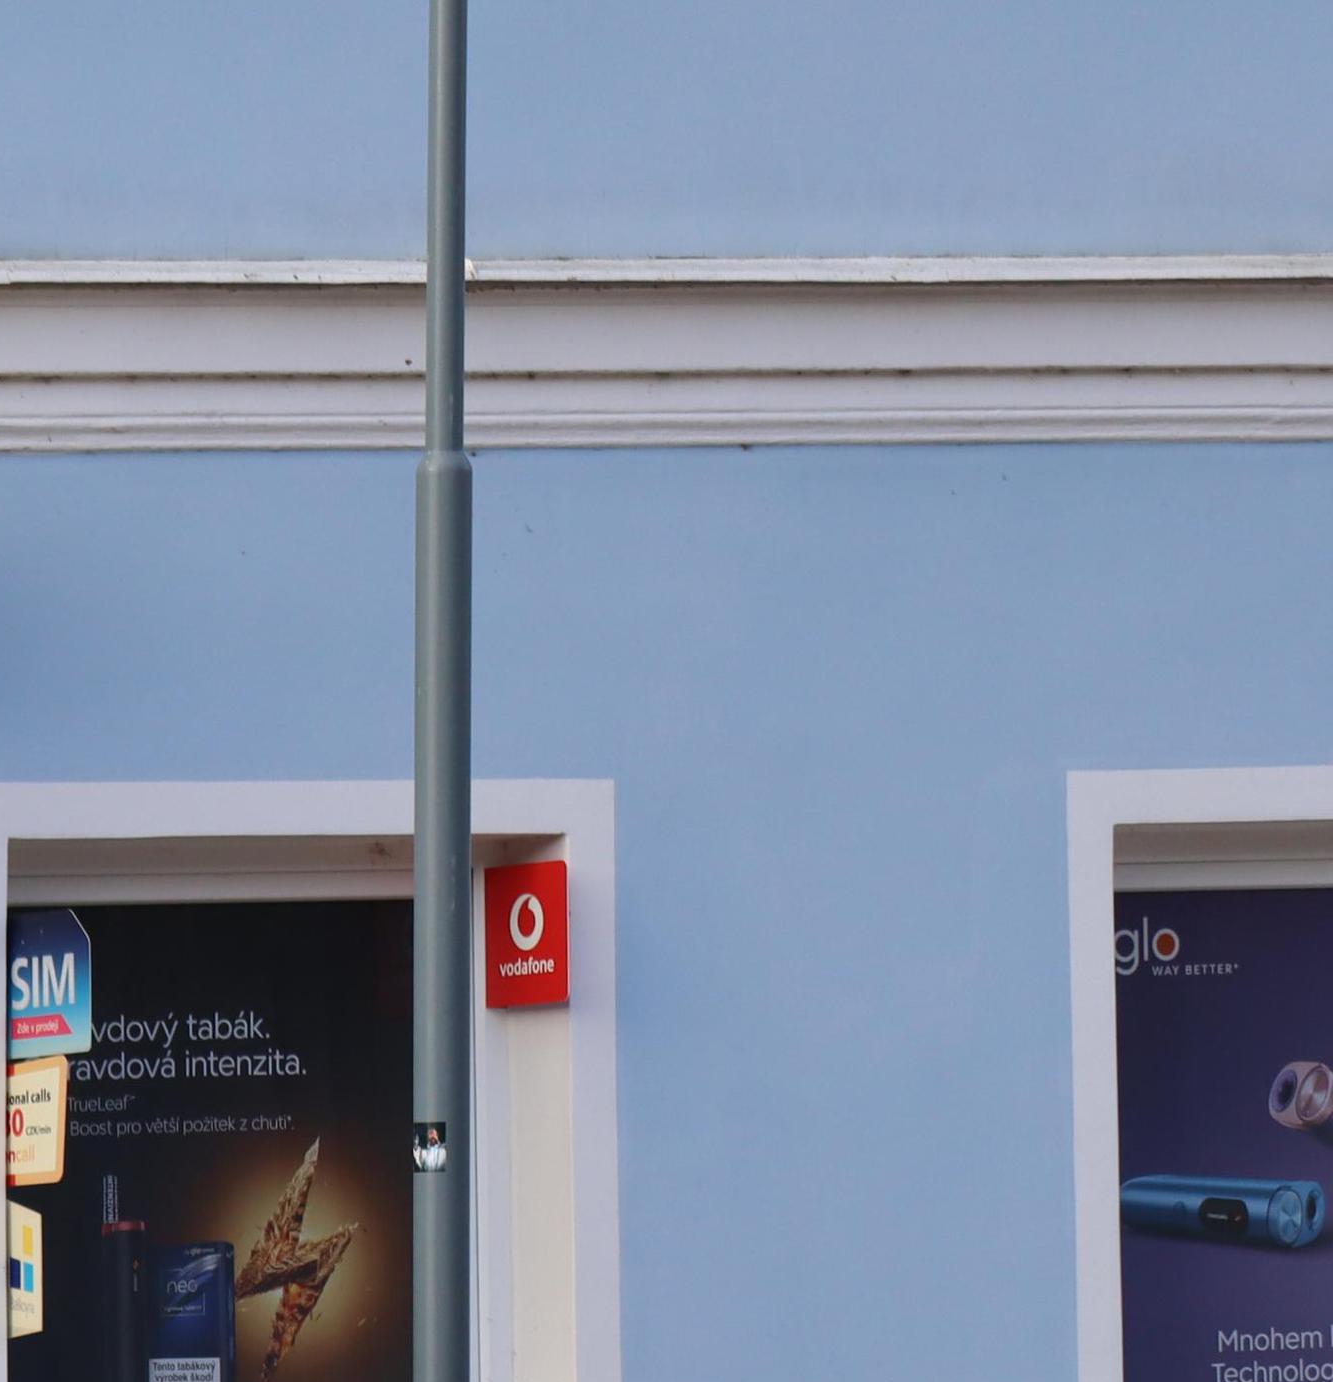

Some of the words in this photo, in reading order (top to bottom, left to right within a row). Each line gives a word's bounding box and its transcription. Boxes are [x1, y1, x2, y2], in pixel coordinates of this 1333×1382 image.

[1115, 916, 1180, 976] glo
[499, 957, 555, 976] vodafone
[1152, 965, 1180, 976] WAY
[10, 952, 76, 1011] SIM
[17, 1022, 30, 1034] Zde
[186, 1011, 271, 1041] tabák.
[184, 1051, 307, 1079] intenzita.
[31, 1089, 51, 1104] calls
[70, 1116, 114, 1137] Boost
[116, 1119, 142, 1139] pro
[145, 1114, 179, 1135] větší
[183, 1113, 235, 1137] požitek
[238, 1118, 248, 1131] z
[1218, 1329, 1322, 1353] Mnohem
[153, 1361, 175, 1372] Tento
[177, 1360, 216, 1373] tabákový
